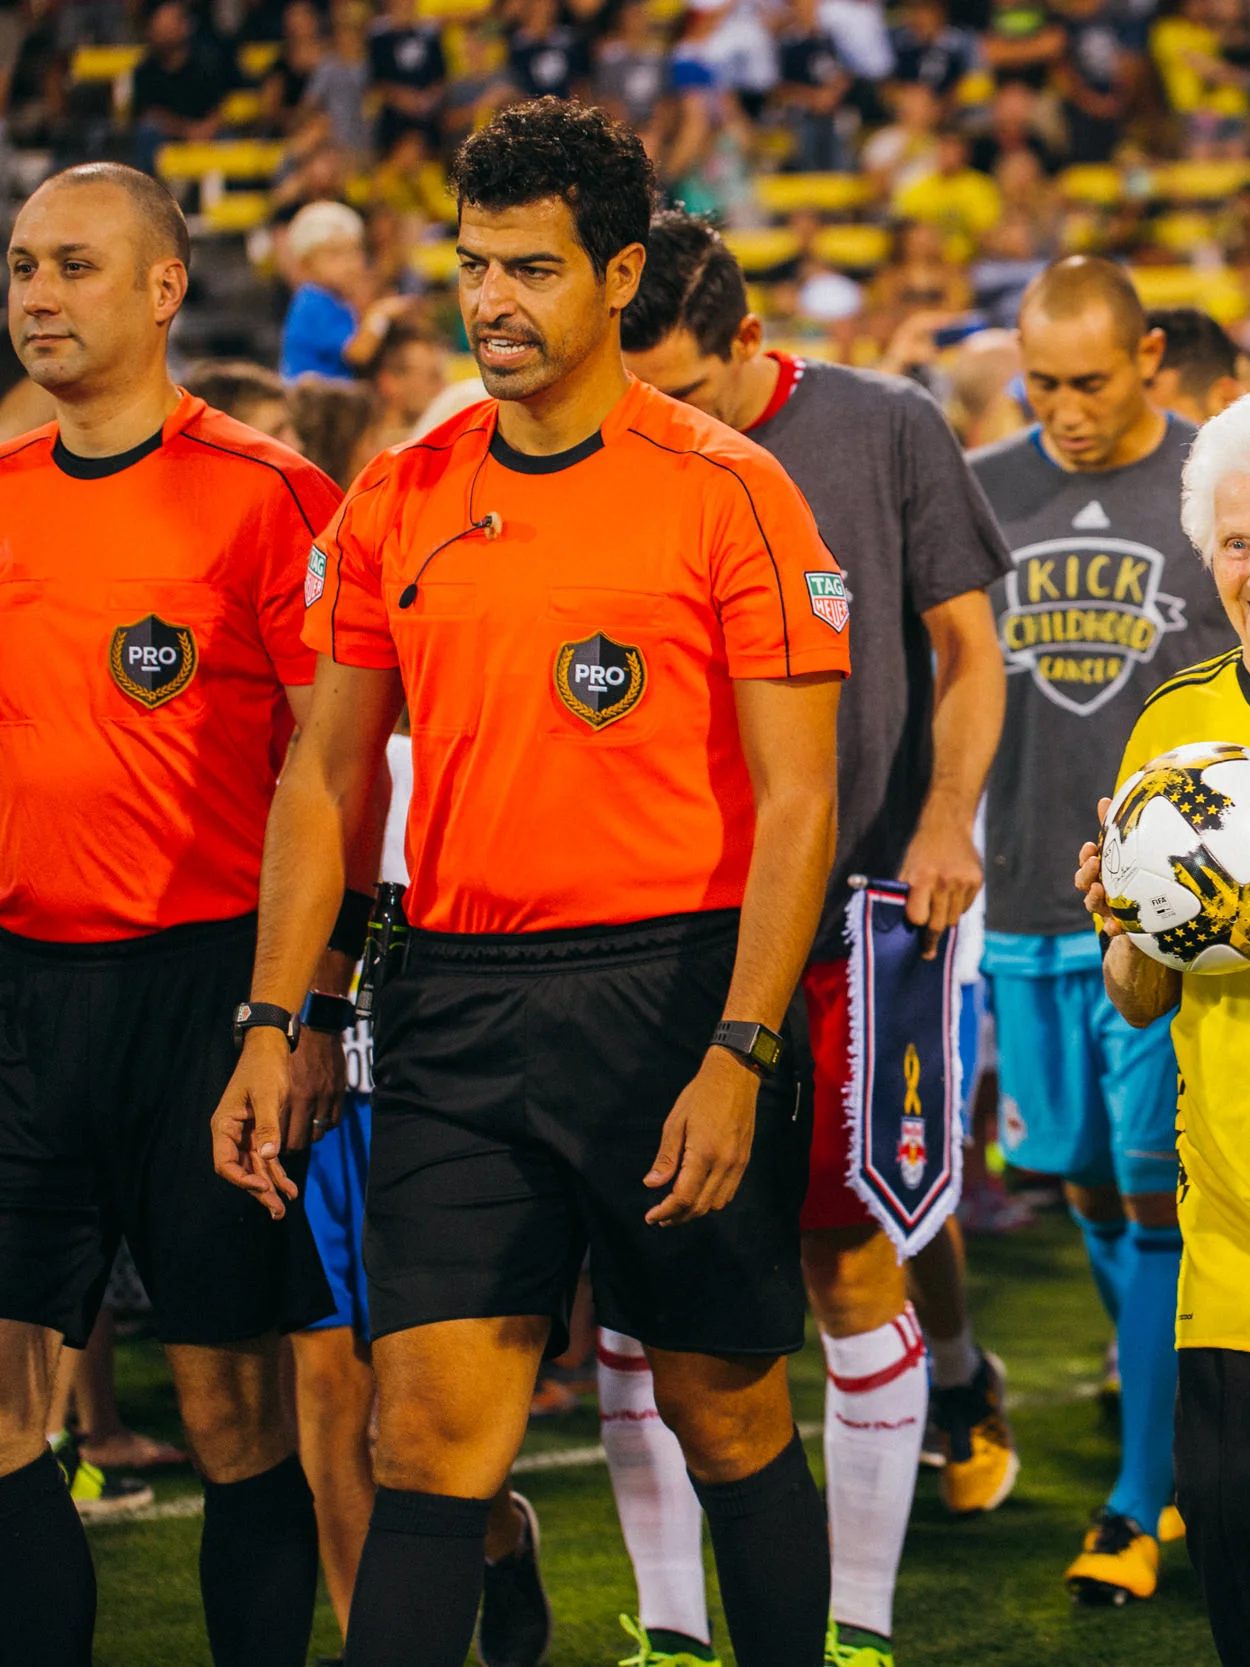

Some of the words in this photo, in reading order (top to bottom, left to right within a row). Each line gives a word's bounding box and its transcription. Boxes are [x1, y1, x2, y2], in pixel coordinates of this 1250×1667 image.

[811, 577, 843, 596] TAG
[1027, 554, 1148, 603] KICK
[814, 599, 848, 626] HEUER
[128, 646, 177, 665] PRO
[575, 664, 625, 686] PRO
[1151, 896, 1168, 906] FIFA
